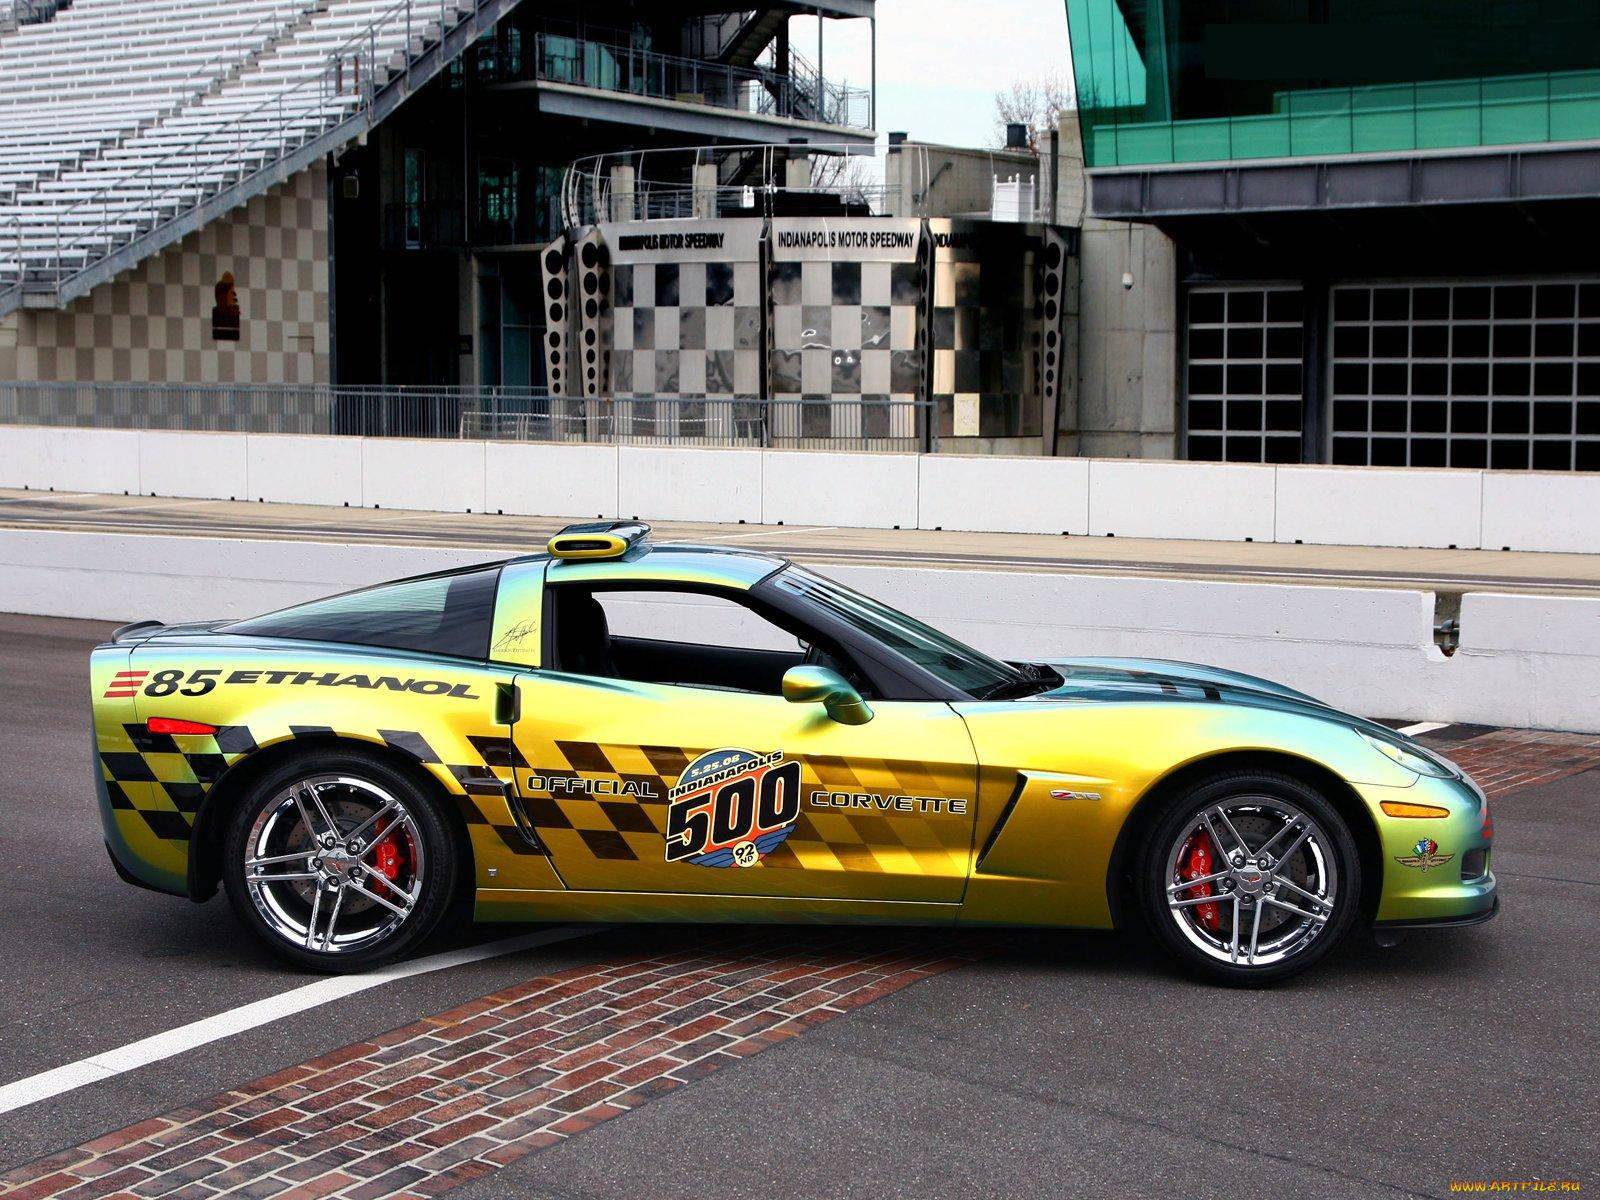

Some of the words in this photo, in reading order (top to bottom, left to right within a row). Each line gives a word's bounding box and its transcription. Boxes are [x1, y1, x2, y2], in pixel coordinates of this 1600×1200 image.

[685, 232, 724, 249] SPEEDWAY
[778, 231, 836, 247] INDIANAPOLIS
[838, 232, 868, 247] MOTOR
[870, 232, 914, 247] SPEEDWAY
[224, 670, 480, 700] ETHANOL
[669, 751, 783, 799] INDIANAPOLIS
[691, 754, 741, 777] 5.25.08
[526, 775, 659, 798] OFFICIAL
[665, 760, 802, 862] 500
[810, 791, 967, 814] CORVETTE
[735, 844, 755, 858] 92
[740, 855, 753, 864] ND
